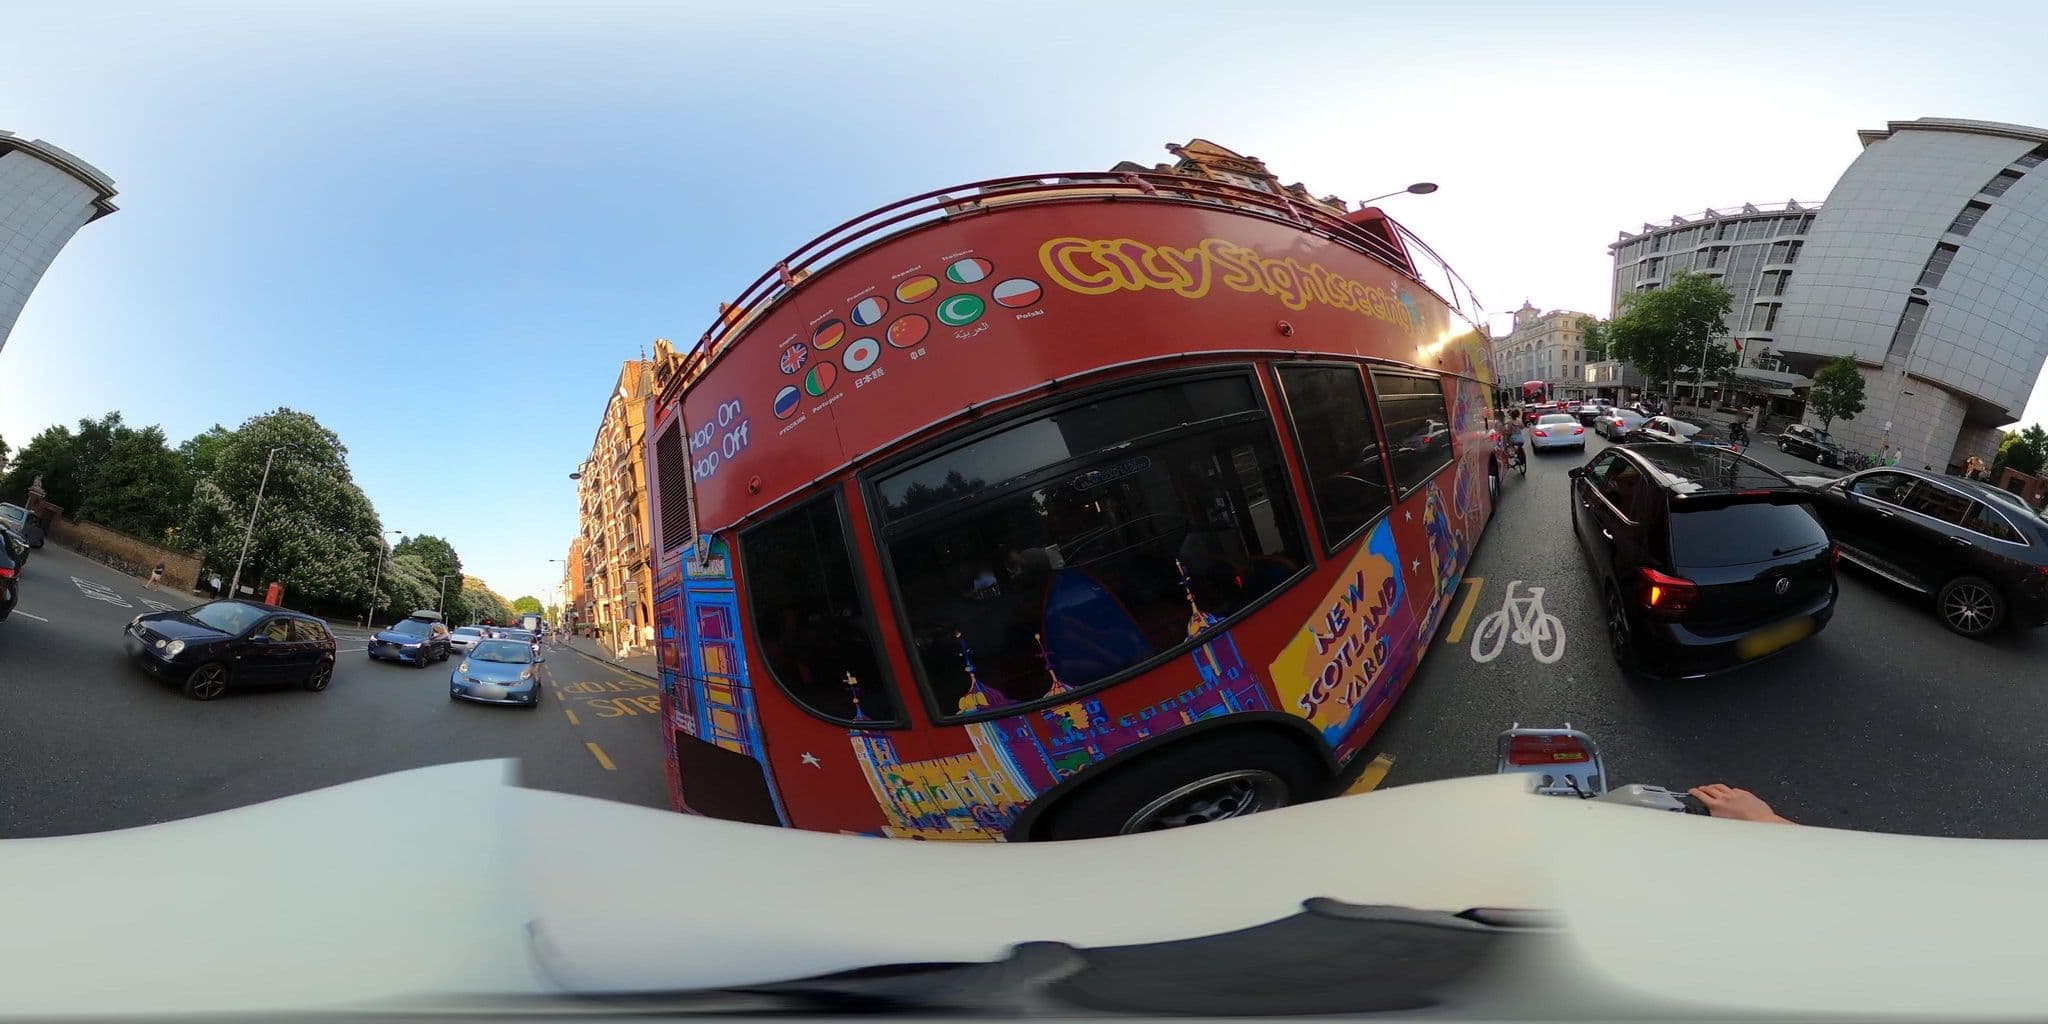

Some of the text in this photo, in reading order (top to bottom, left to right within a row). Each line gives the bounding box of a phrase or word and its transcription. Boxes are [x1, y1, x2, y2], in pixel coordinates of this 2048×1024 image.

[1015, 309, 1045, 321] Polski
[718, 399, 741, 427] On
[1297, 577, 1397, 721] SCOTLAND
[1310, 570, 1366, 655] NEW
[1337, 635, 1389, 709] YARD
